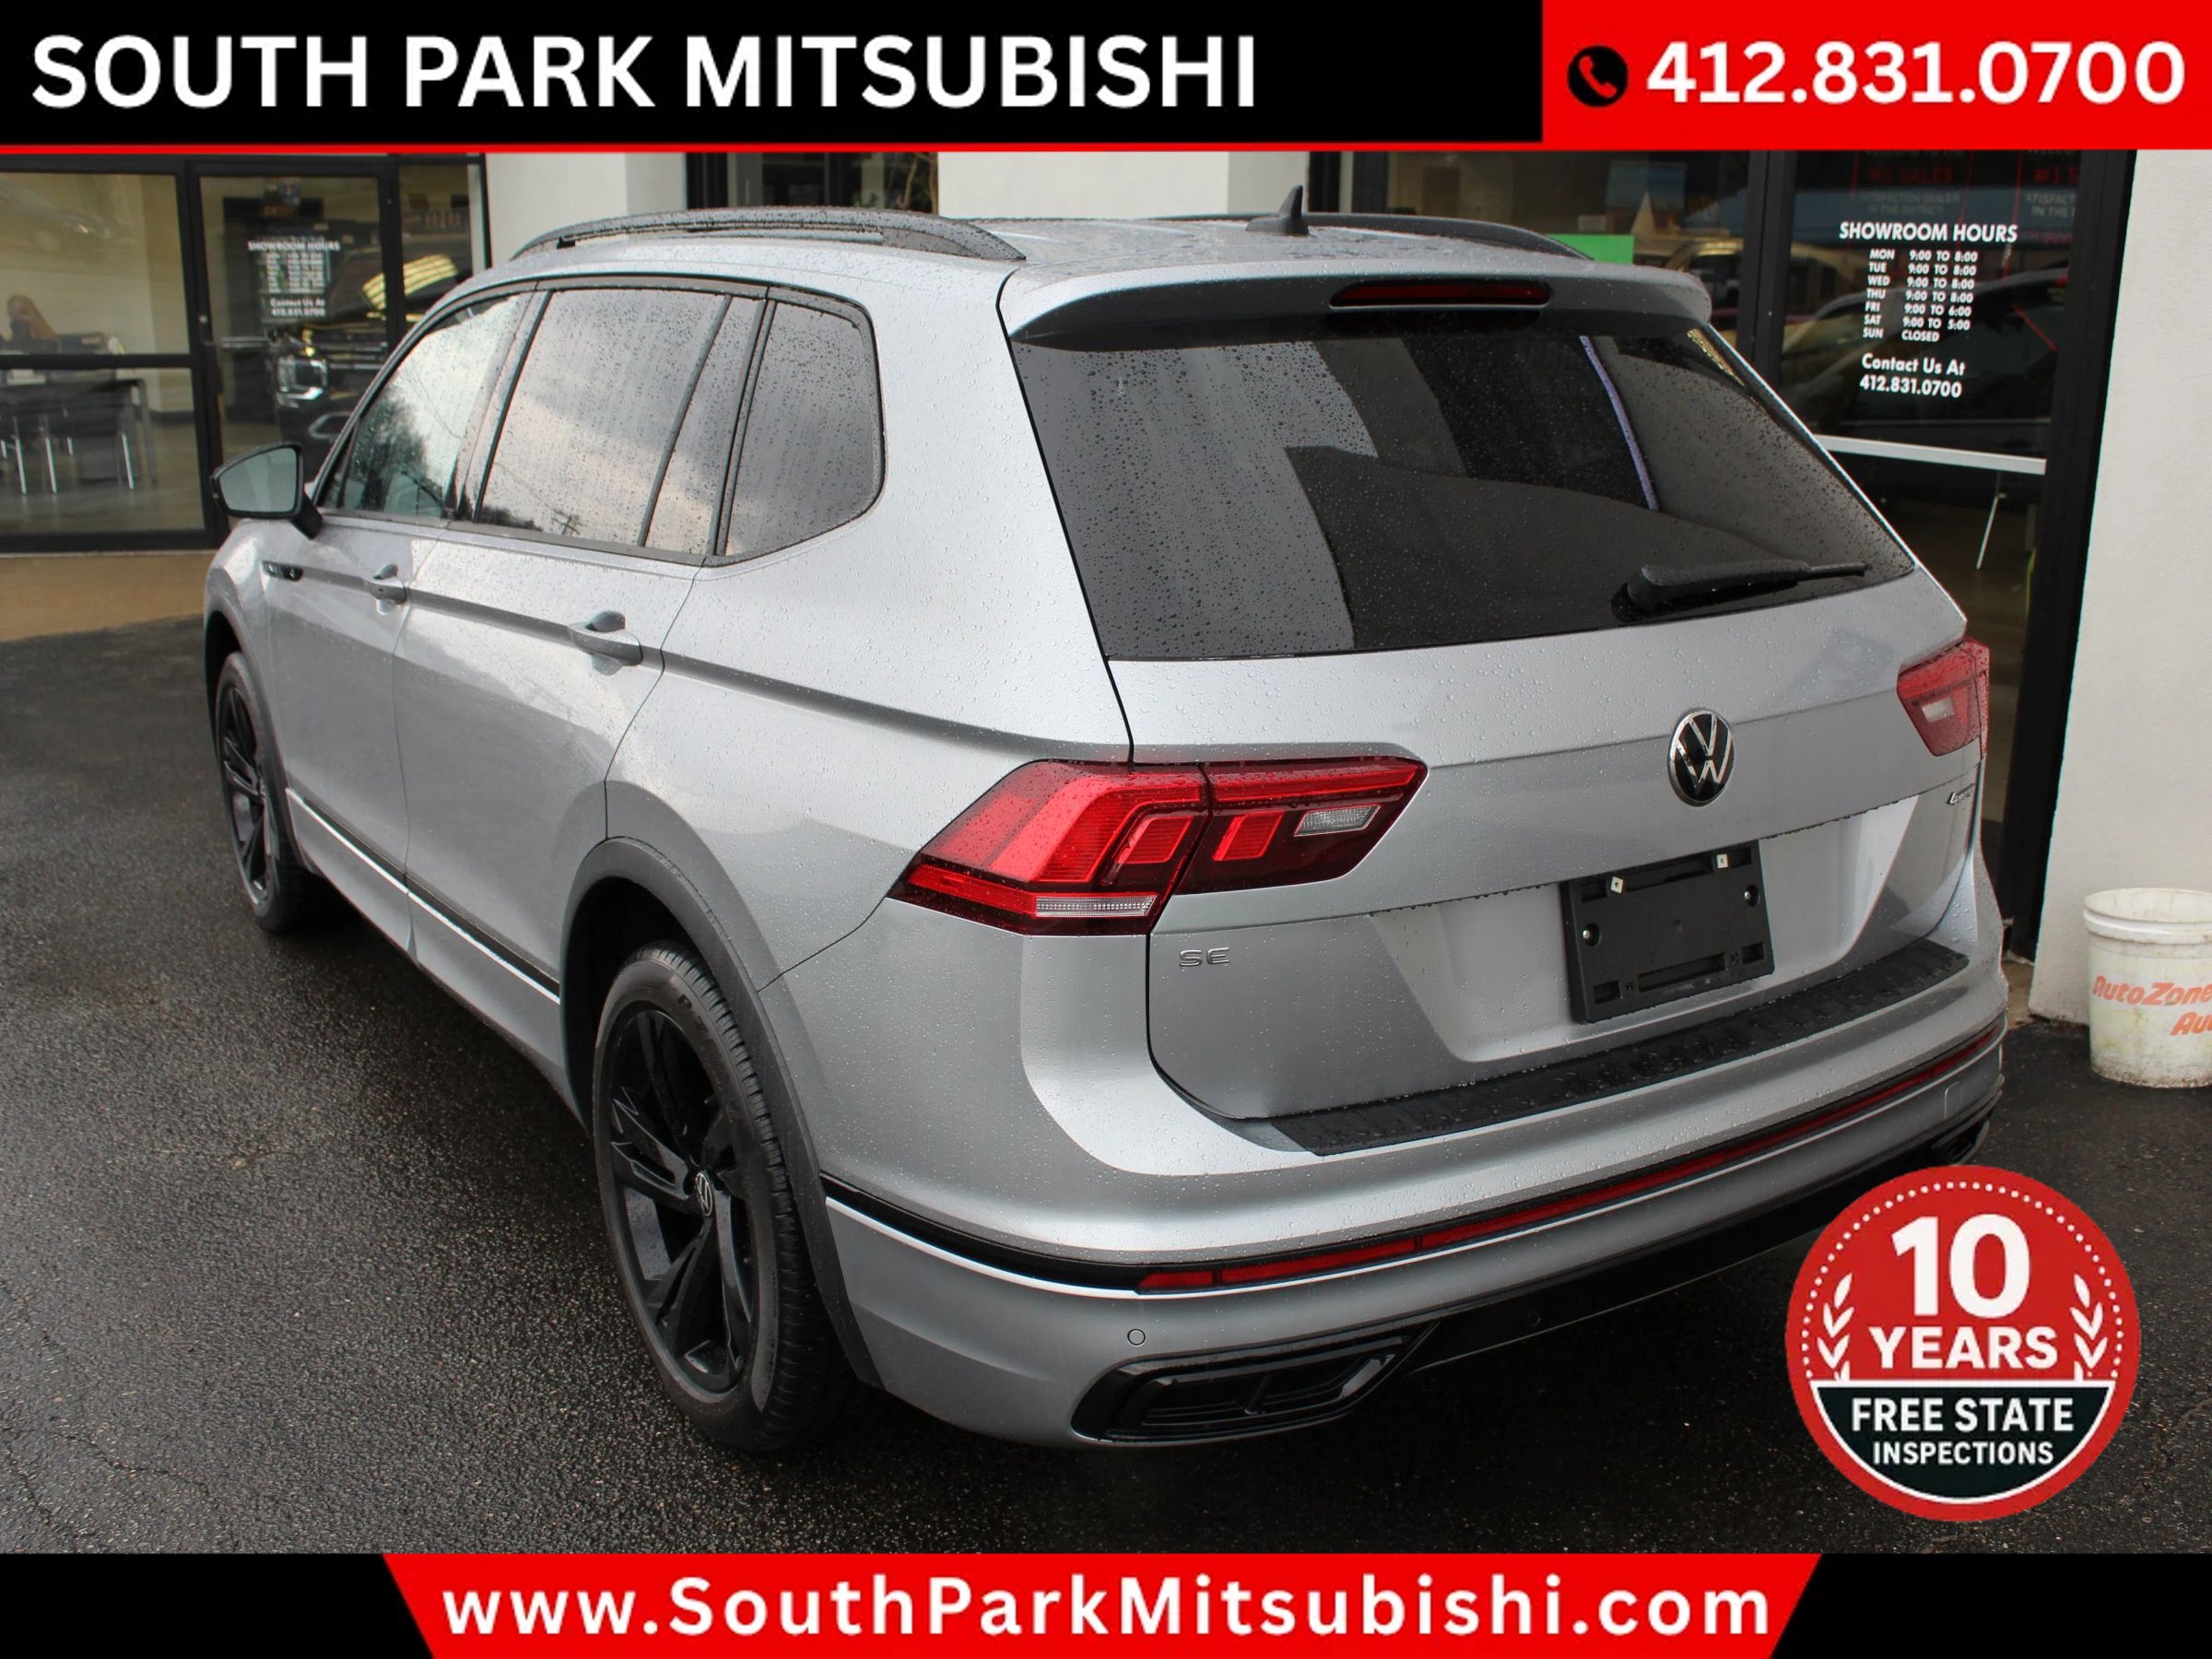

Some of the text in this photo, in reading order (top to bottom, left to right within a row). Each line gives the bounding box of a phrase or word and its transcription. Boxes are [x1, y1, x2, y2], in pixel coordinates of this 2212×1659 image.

[1838, 220, 1948, 242] SHOWROOM
[1952, 223, 2018, 243] HOURS
[1869, 249, 1978, 263] MON 9:00 TO 8:00
[1868, 261, 1977, 276] TUE 9:00 TO 8:00
[1867, 275, 1975, 290] WED 9:00 TO 8:00
[1866, 288, 1974, 304] THU 9:00 TO 8:00
[1865, 300, 1972, 317] FRI 9:00 TO 6:00
[1864, 314, 1971, 331] SAT 9:00 TO 5:00
[1863, 327, 1940, 342] SUN CLOSED
[1861, 352, 1966, 377] Contact Us At
[1859, 373, 1962, 398] 412.831.0700
[1180, 947, 1230, 967] SE
